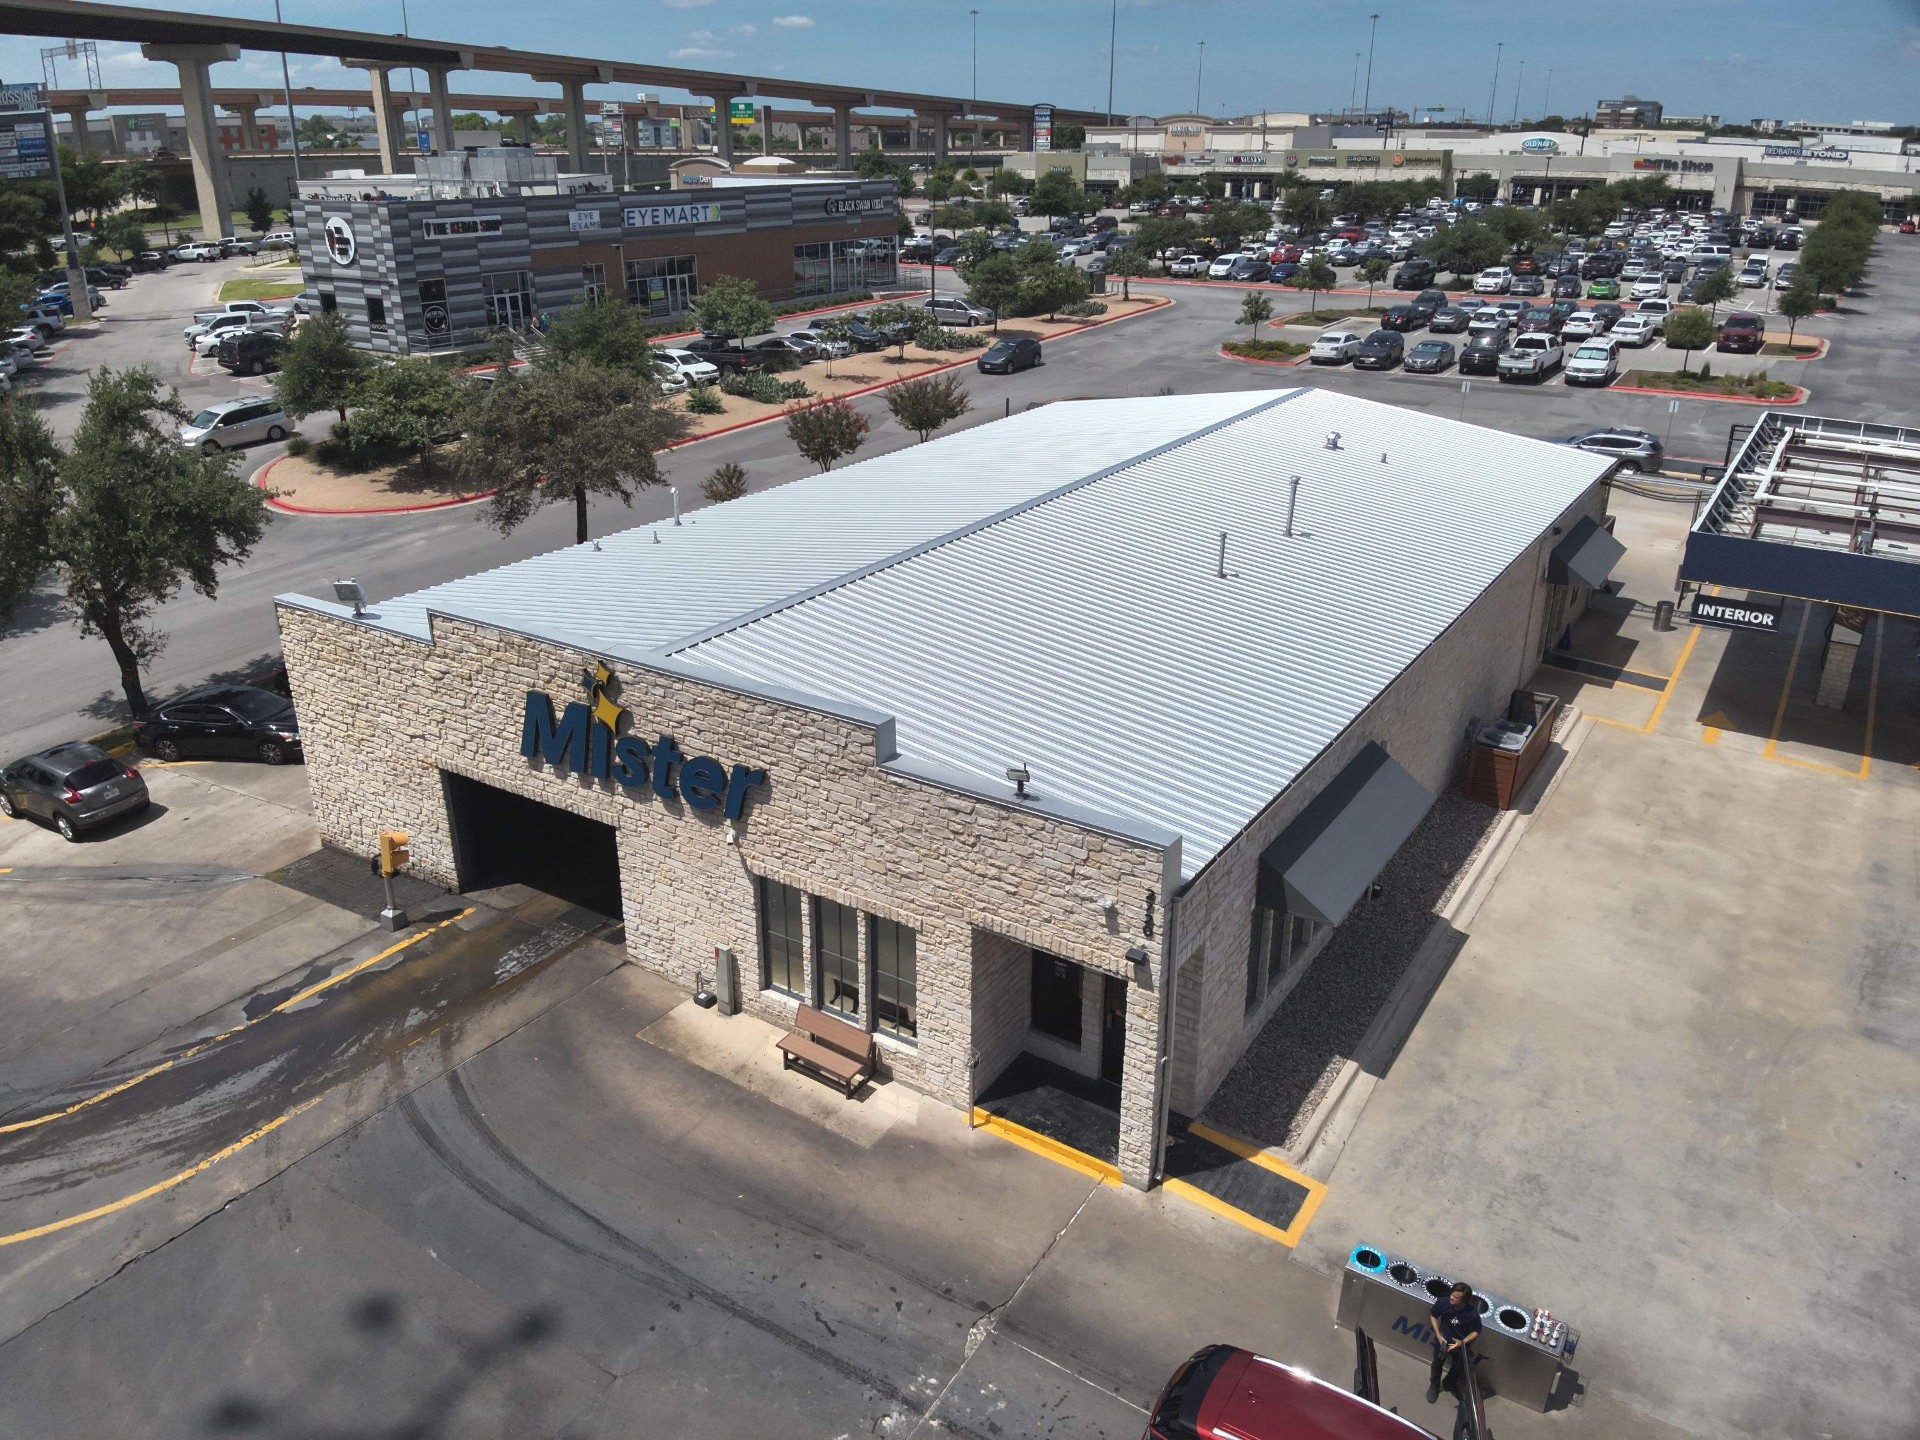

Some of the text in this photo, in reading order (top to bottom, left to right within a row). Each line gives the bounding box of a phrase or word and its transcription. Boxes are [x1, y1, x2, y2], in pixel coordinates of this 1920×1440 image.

[1802, 149, 1847, 160] BEYOND
[1681, 160, 1714, 173] Shop
[577, 212, 595, 221] EYE
[626, 205, 710, 227] EYEMART
[1698, 603, 1774, 626] INTERIOR
[520, 689, 767, 821] Mister
